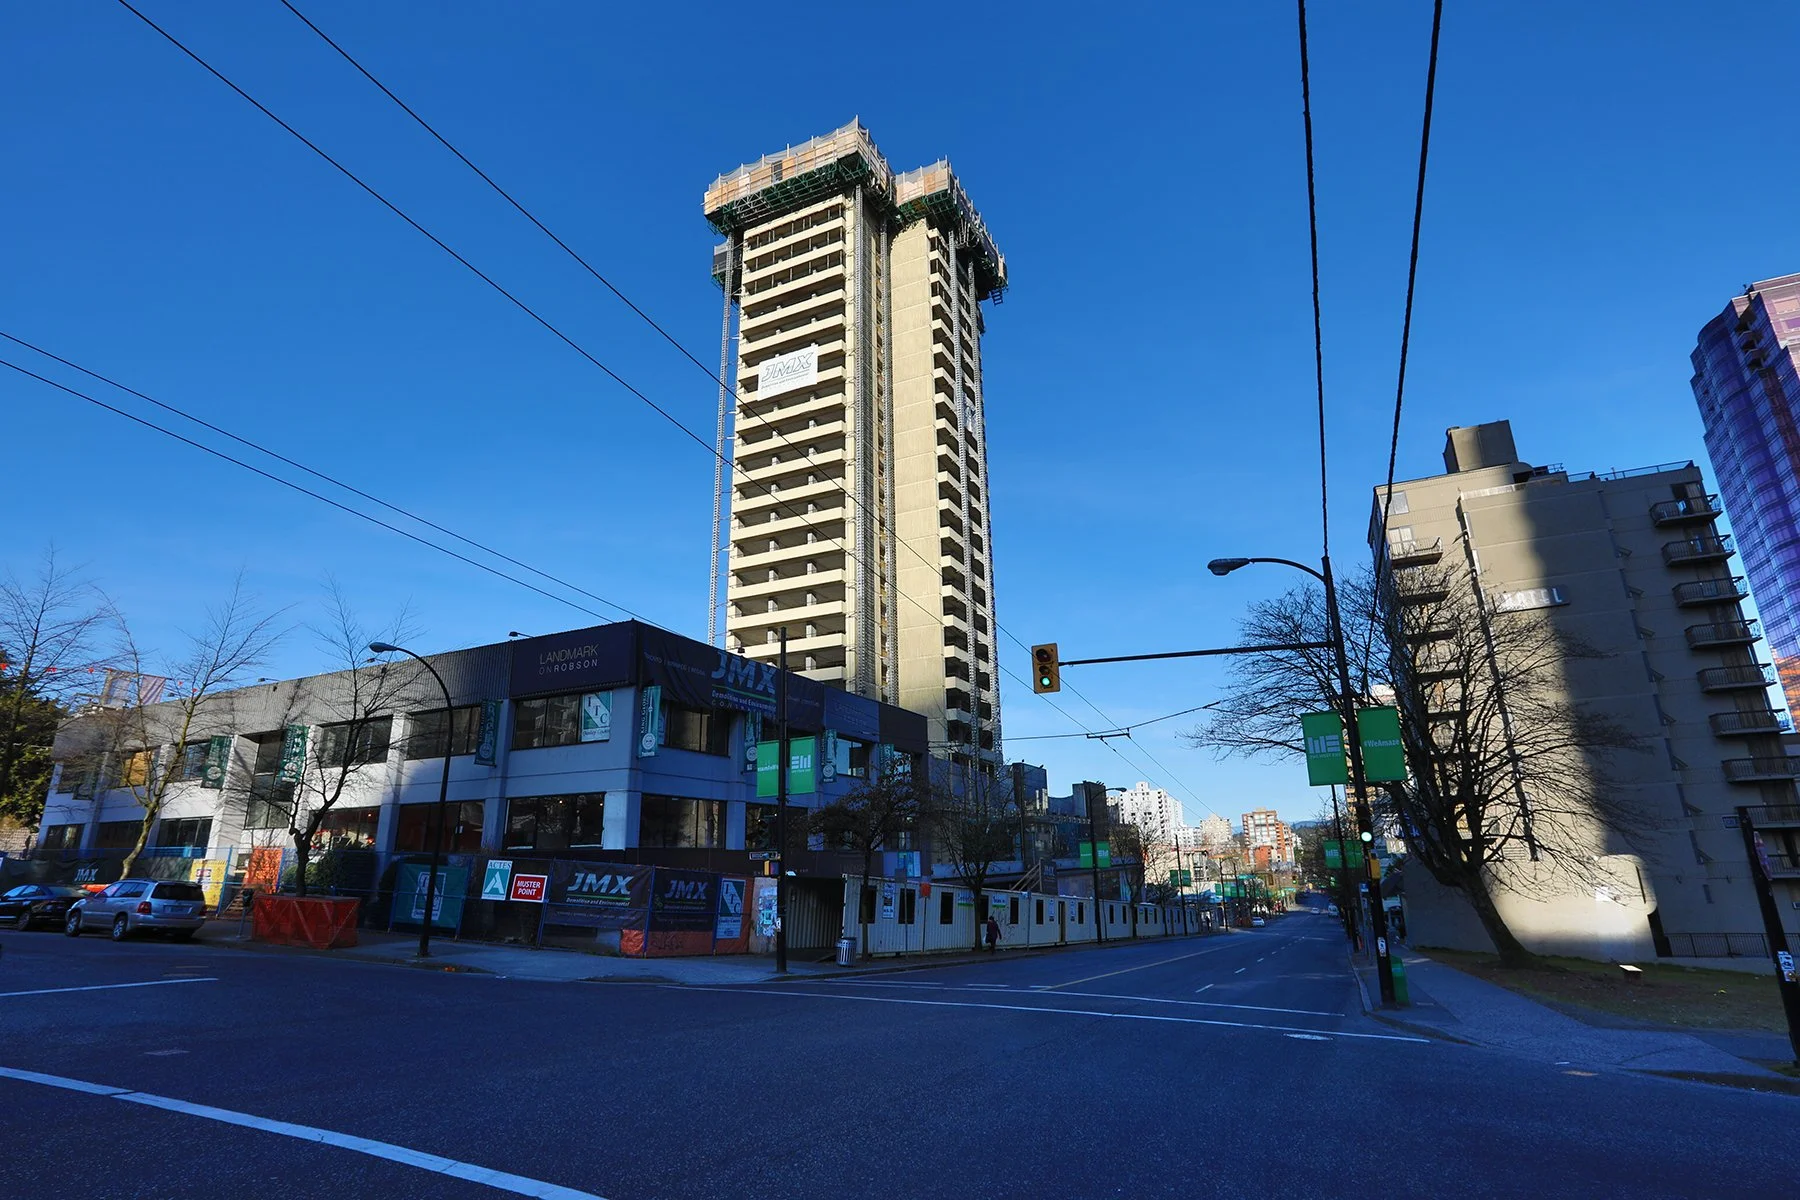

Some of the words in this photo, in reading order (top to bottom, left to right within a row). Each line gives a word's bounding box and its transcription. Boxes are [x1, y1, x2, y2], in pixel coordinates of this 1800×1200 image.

[761, 352, 814, 382] JMX
[540, 643, 600, 665] LANDMARK
[711, 650, 777, 695] JMX
[74, 868, 99, 882] JMX
[517, 880, 541, 888] MUSTER
[566, 872, 635, 895] JMX
[517, 888, 537, 896] POINT
[664, 879, 709, 900] JMX
